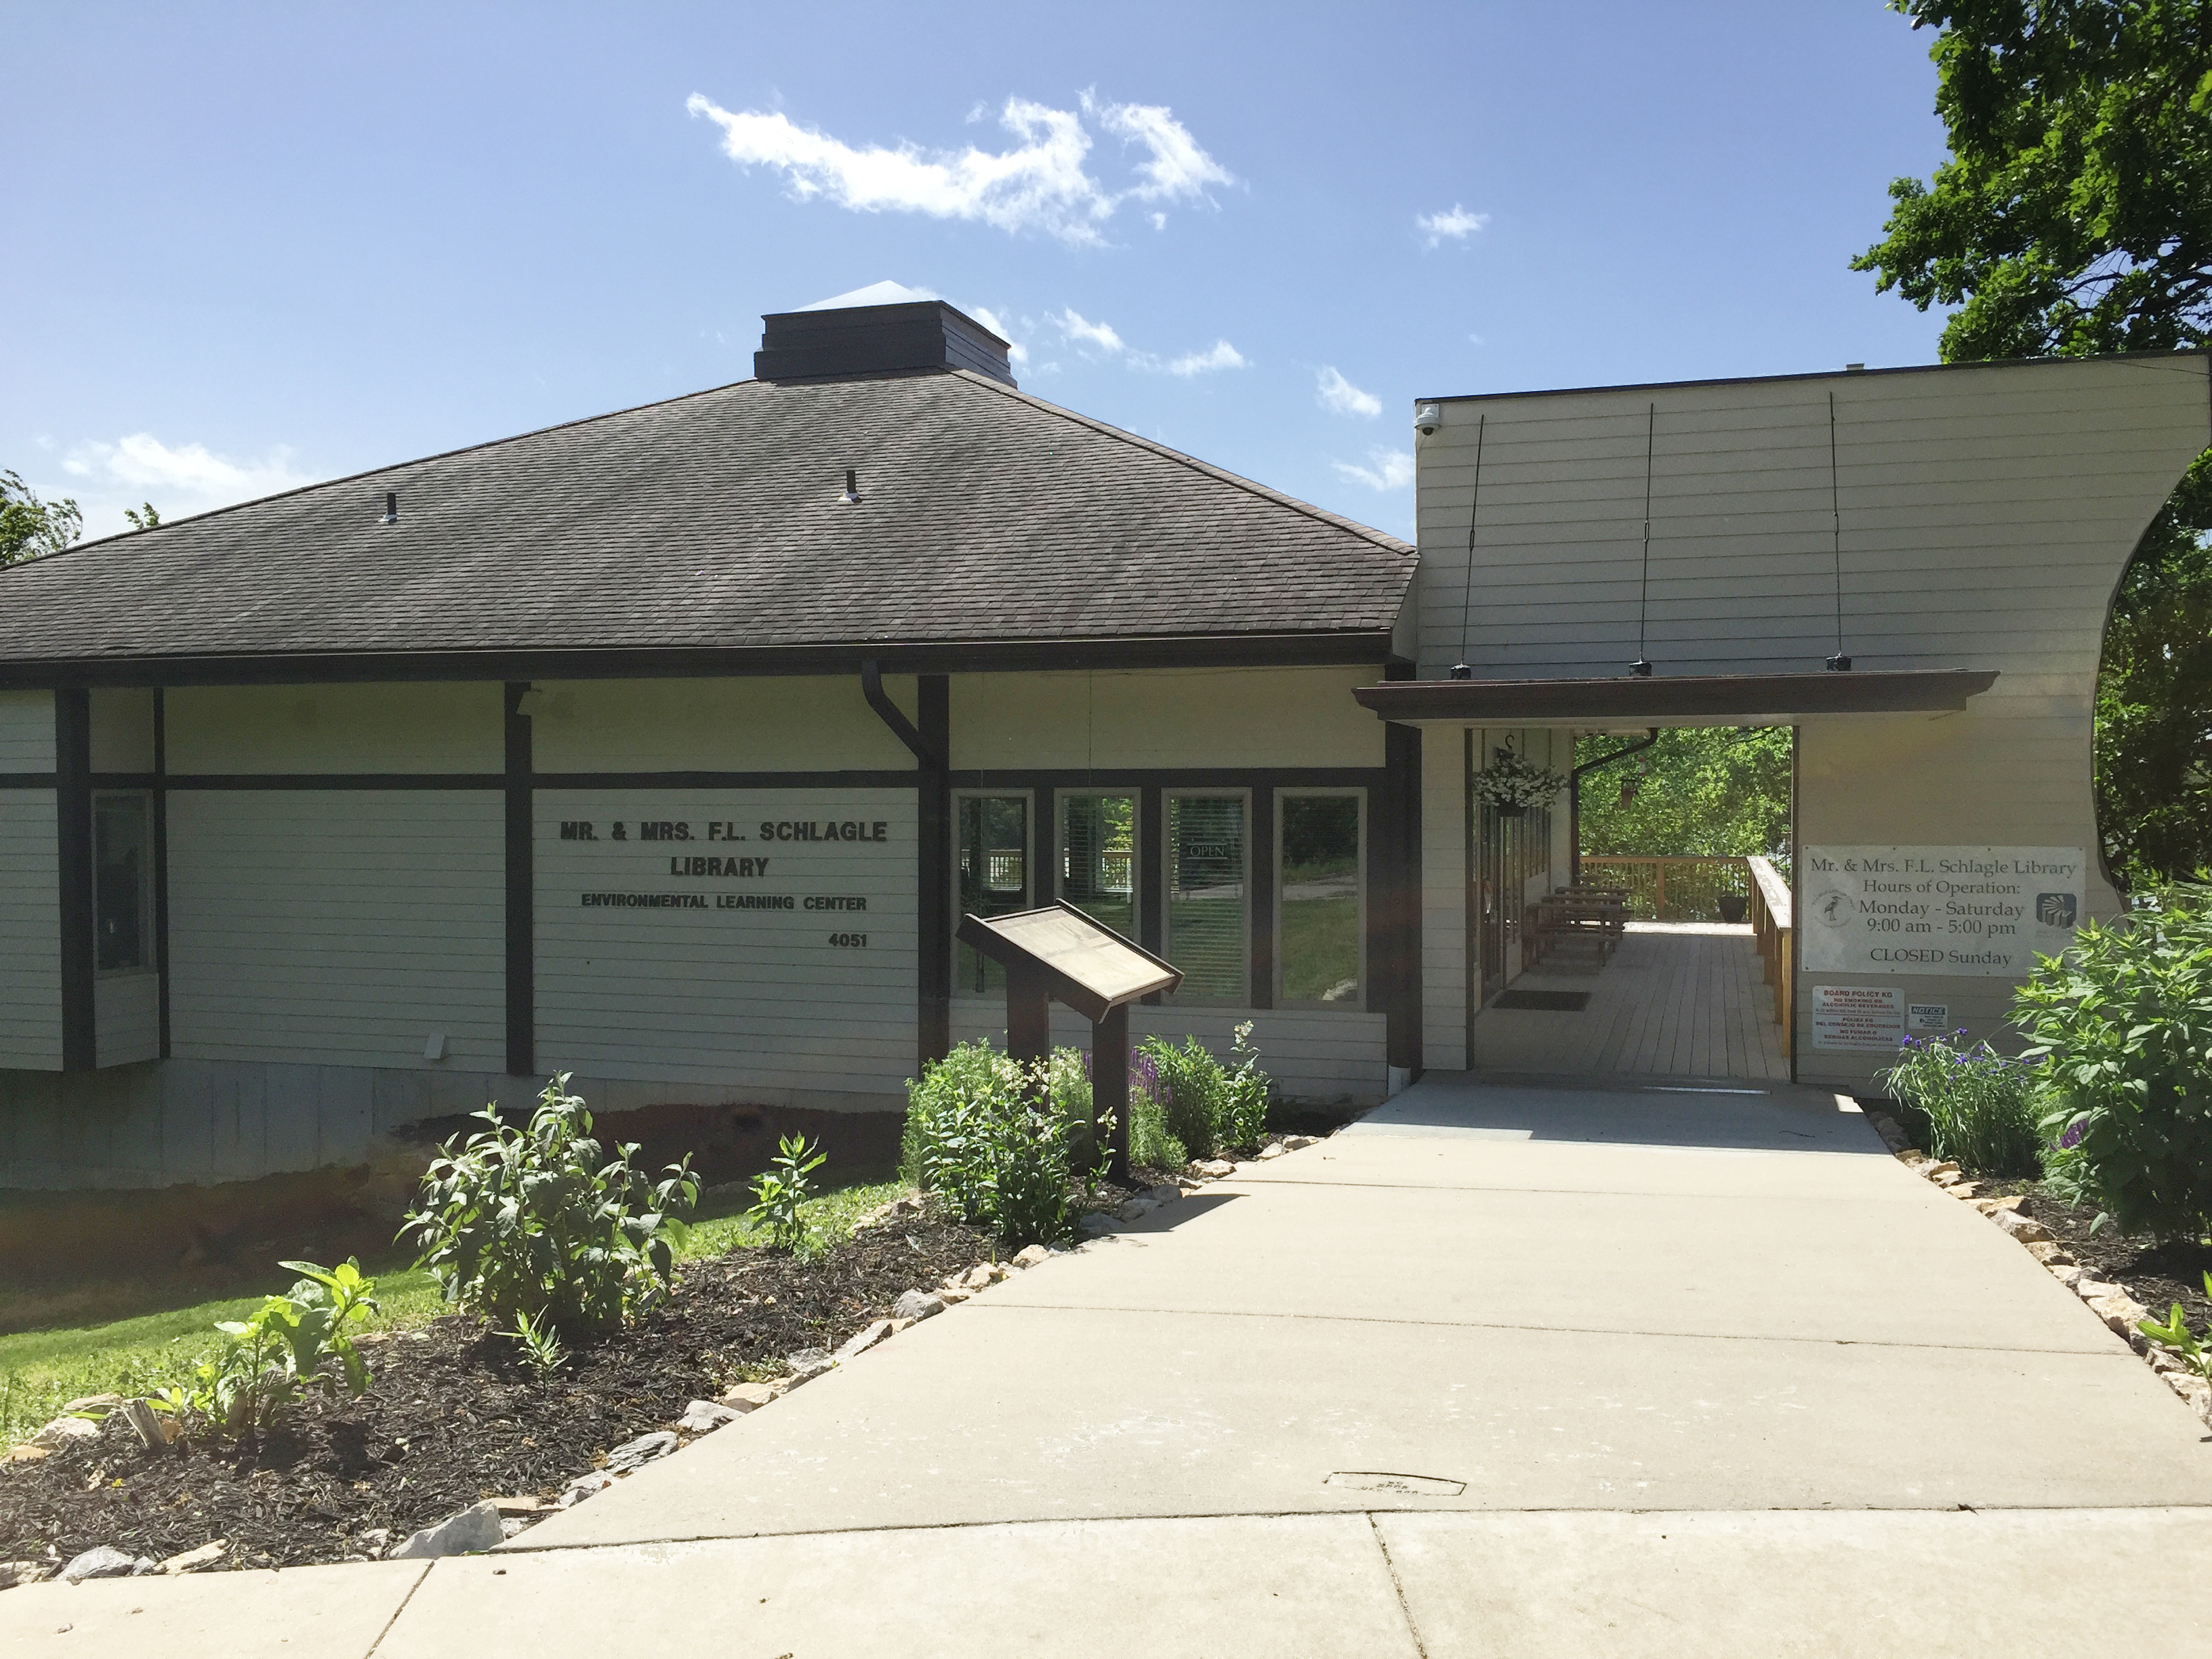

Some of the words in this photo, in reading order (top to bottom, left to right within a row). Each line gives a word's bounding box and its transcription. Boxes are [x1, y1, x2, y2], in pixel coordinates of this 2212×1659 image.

[560, 821, 598, 840] MR.
[611, 822, 626, 840] &
[641, 821, 695, 840] MRS.
[709, 822, 745, 841] F.L.
[760, 822, 888, 842] SCHLAGLE
[1190, 846, 1224, 857] OPEN
[670, 857, 769, 877] LIBRARY
[1811, 858, 1839, 872] Mr.
[1844, 859, 1858, 872] &
[1862, 859, 1898, 873] Mrs.
[1905, 860, 1934, 874] F.L.
[1940, 859, 2009, 878] Schlagle
[2013, 860, 2078, 878] Library
[1862, 880, 1912, 893] Hours
[1916, 879, 1933, 893] of
[1936, 880, 2020, 897] Operation:
[581, 894, 709, 909] ENVIRONMENTAL
[716, 895, 794, 910] LEARNING
[803, 896, 867, 911] CENTER
[1859, 900, 1931, 919] Monday
[1946, 901, 2025, 921] Saturday
[1867, 918, 1900, 933] 9:00
[1905, 922, 1931, 933] am
[1948, 920, 1982, 935] 5:00
[1987, 923, 2017, 939] pm
[828, 933, 867, 947] 4051
[1870, 948, 1944, 963] CLOSED
[1948, 949, 2013, 968] Sunday
[1912, 1006, 1944, 1015] NOTICE
